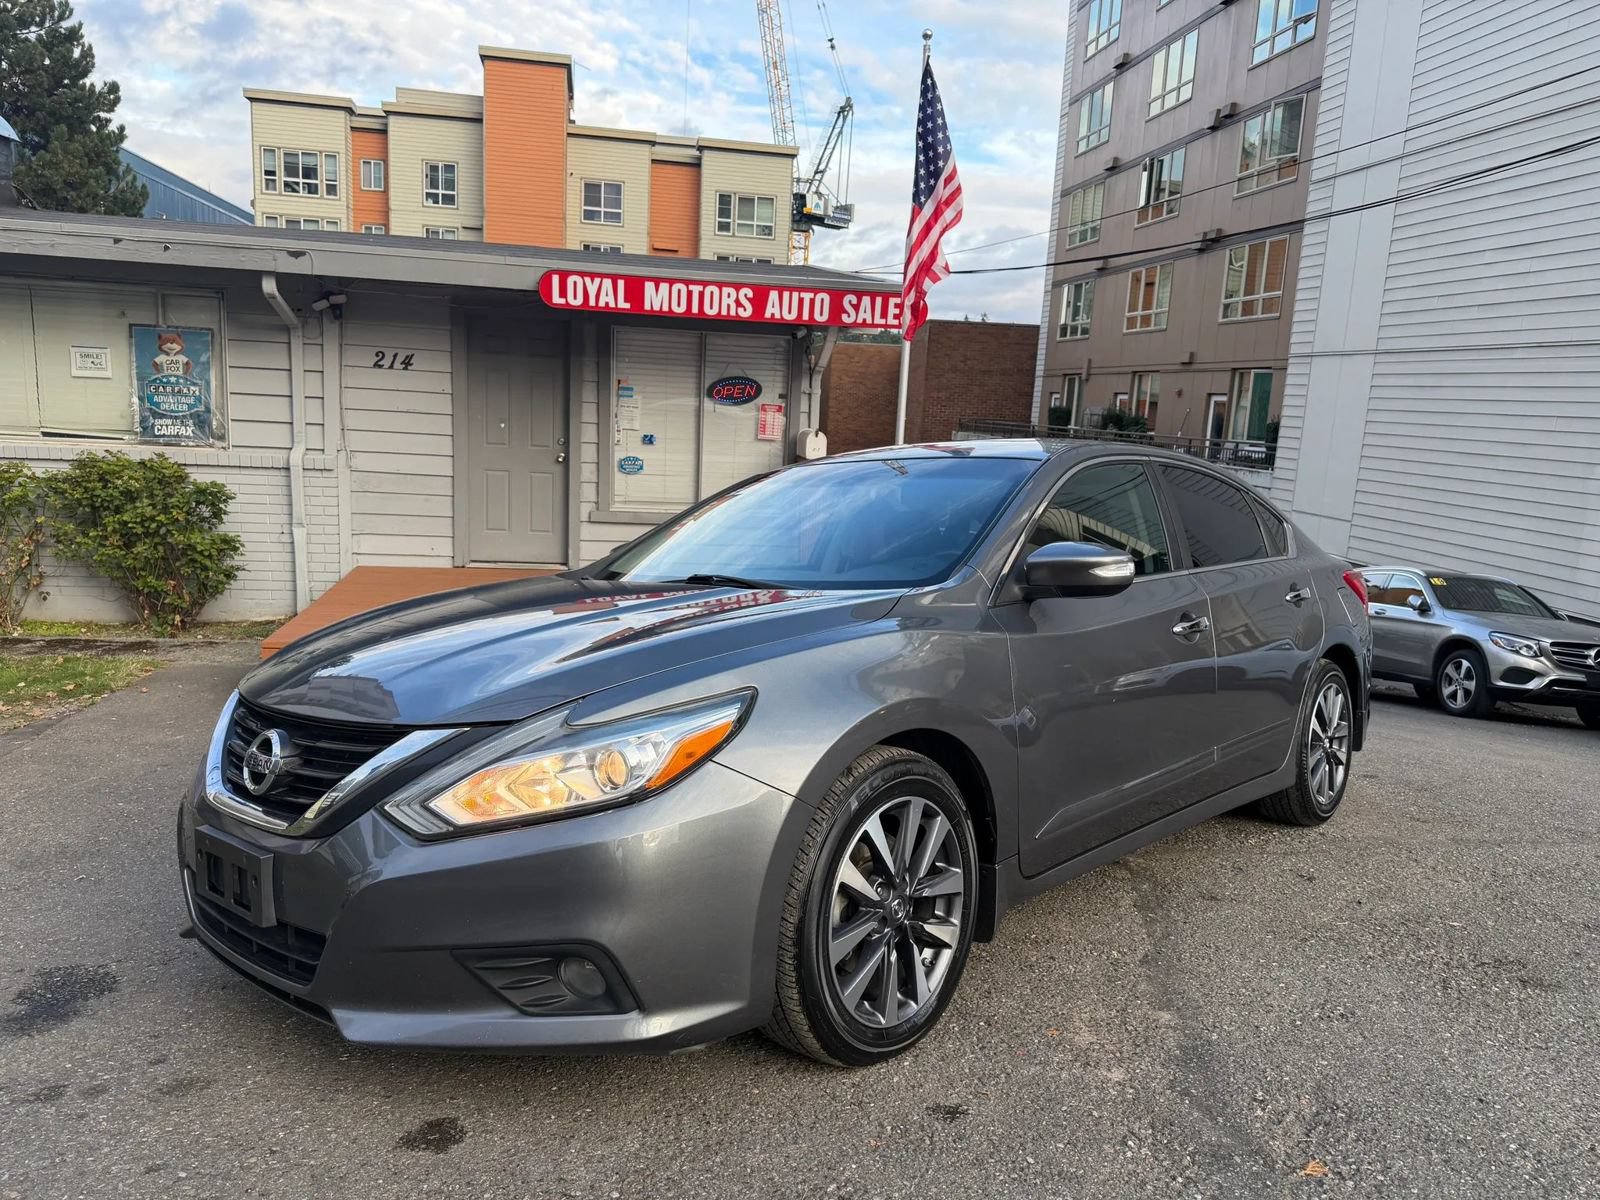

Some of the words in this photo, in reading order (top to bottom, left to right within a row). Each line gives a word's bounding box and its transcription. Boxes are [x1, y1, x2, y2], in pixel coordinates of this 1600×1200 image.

[551, 274, 631, 309] LOYAL
[644, 281, 753, 318] MOTORS
[764, 290, 830, 322] AUTO
[841, 294, 903, 326] SALE
[373, 350, 415, 370] 214
[150, 385, 199, 396] CARFAX
[712, 385, 757, 398] OPEN
[153, 395, 195, 404] ADVANTAGE
[160, 402, 188, 411] DEALER
[154, 418, 173, 426] SHOW
[154, 425, 195, 436] CARFAX
